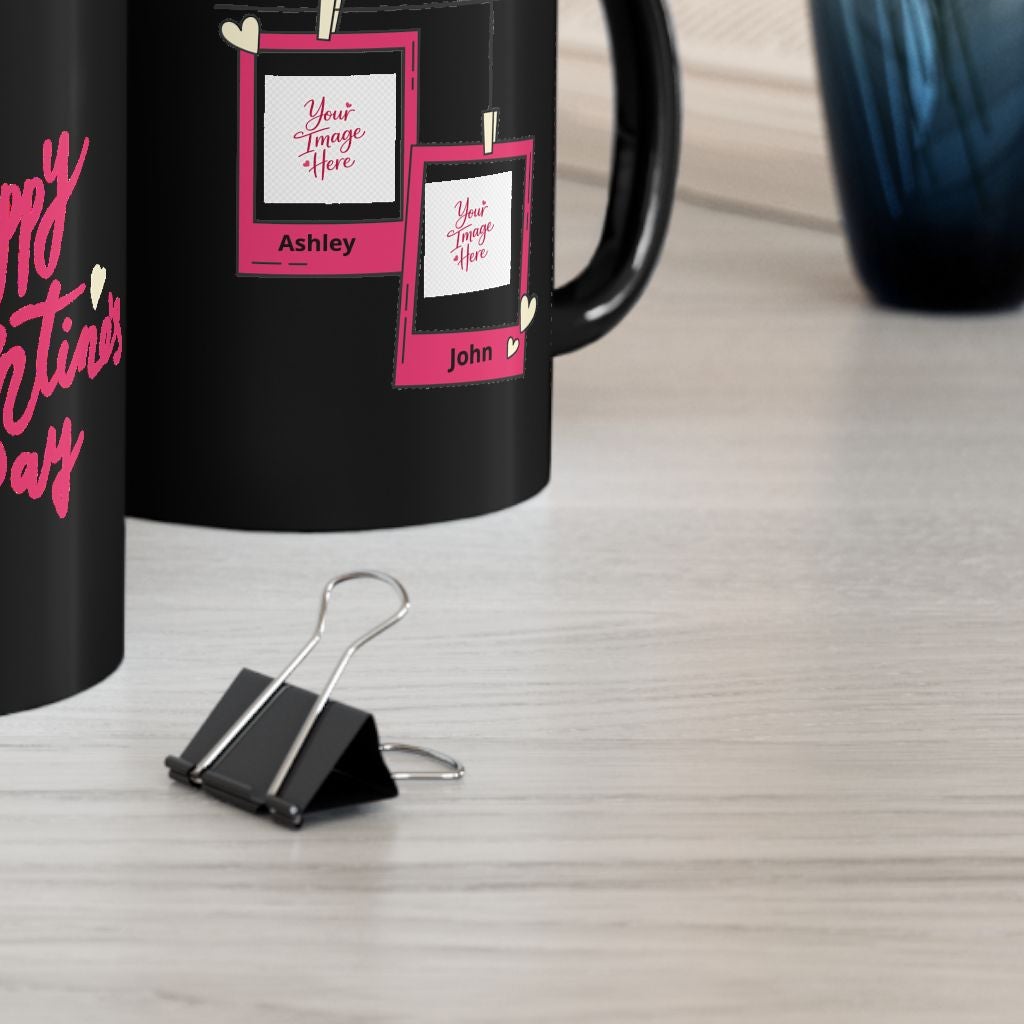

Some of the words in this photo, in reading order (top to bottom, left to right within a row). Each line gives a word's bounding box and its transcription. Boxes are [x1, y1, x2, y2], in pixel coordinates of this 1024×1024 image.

[304, 96, 356, 131] Your
[293, 127, 366, 158] Image
[308, 149, 356, 181] Here
[454, 197, 489, 230] Your
[278, 234, 356, 257] Ashley
[447, 221, 494, 253] Image
[457, 243, 489, 273] Here
[448, 343, 493, 372] John
